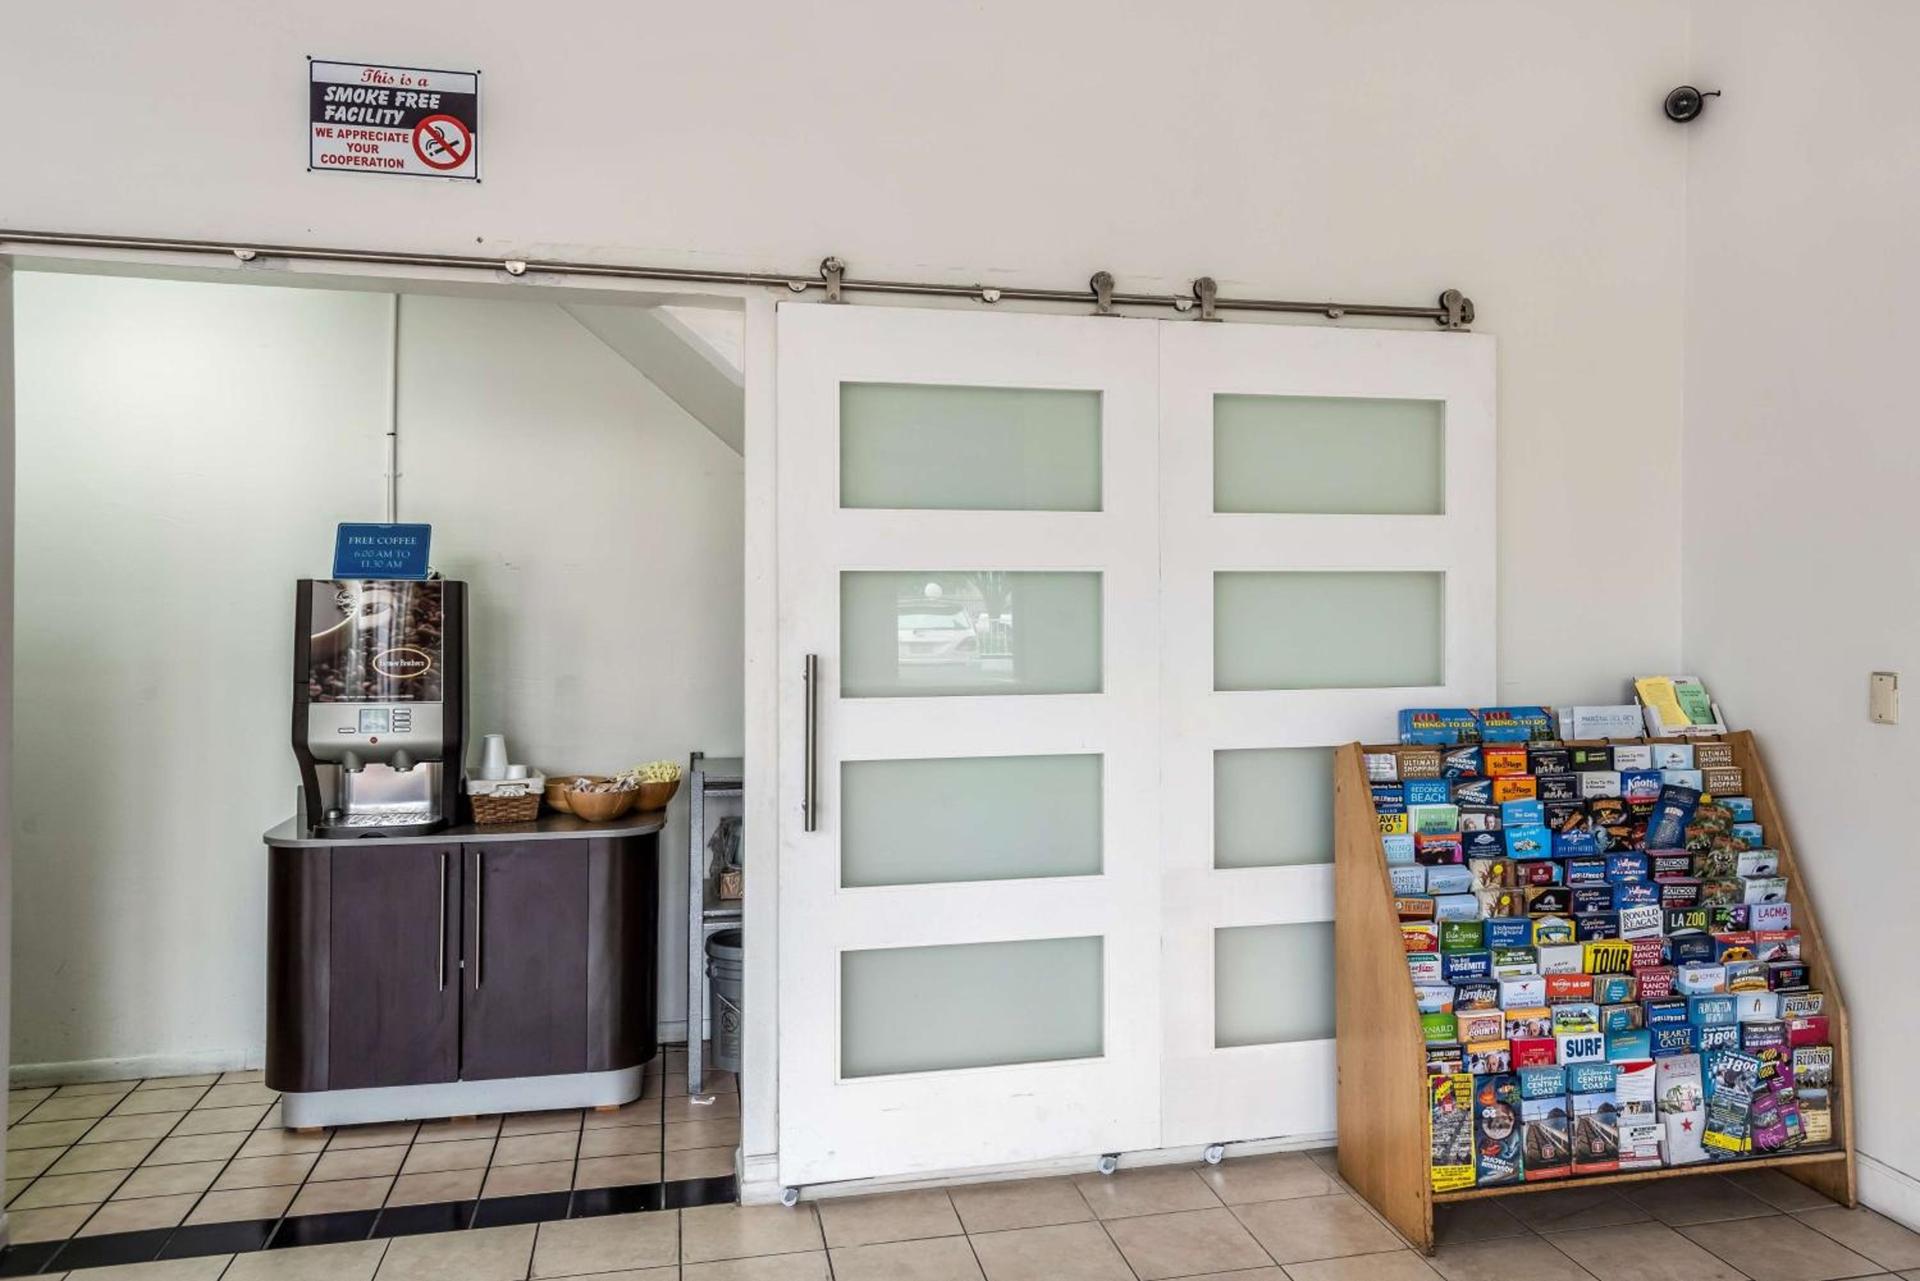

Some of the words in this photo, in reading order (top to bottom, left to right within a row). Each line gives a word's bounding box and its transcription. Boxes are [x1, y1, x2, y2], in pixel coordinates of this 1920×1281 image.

[360, 69, 395, 85] This
[400, 73, 412, 86] is
[418, 78, 430, 87] a
[324, 86, 390, 106] SMOKE
[395, 92, 441, 109] FREE
[324, 105, 405, 125] FACILITY
[315, 127, 334, 139] WE
[337, 130, 409, 144] APPRECIATE
[346, 142, 380, 154] YOUR
[320, 153, 405, 169] COOPERATION
[348, 536, 375, 545] FREE
[377, 536, 417, 545] COFFEE
[1485, 719, 1519, 727] THINGS
[1411, 793, 1446, 802] BEACH
[1379, 815, 1403, 823] AVEL
[1623, 908, 1659, 920] RONALD
[1758, 907, 1788, 919] LACMA
[1623, 916, 1660, 929] REAGAN
[1671, 913, 1684, 928] LA
[1686, 912, 1706, 927] ZOO
[1633, 943, 1662, 951] REAGAN
[1633, 951, 1659, 959] RANCH
[1449, 962, 1487, 972] YOSEMITE
[1593, 948, 1630, 975] TOUR
[1641, 974, 1670, 982] REAGAN
[1642, 982, 1669, 990] RANCH
[1641, 989, 1670, 997] CENTER
[1785, 1000, 1819, 1011] RIDING
[1423, 1025, 1454, 1033] XNARD
[1658, 1028, 1691, 1040] HEARST
[1566, 1038, 1602, 1058] SURF
[1660, 1037, 1690, 1048] CASTLE
[1796, 1054, 1831, 1065] RIDING
[1527, 1080, 1563, 1089] CENTRAL
[1577, 1075, 1613, 1084] CENTRAL
[1582, 1082, 1608, 1090] COAST
[1531, 1088, 1558, 1096] COAST
